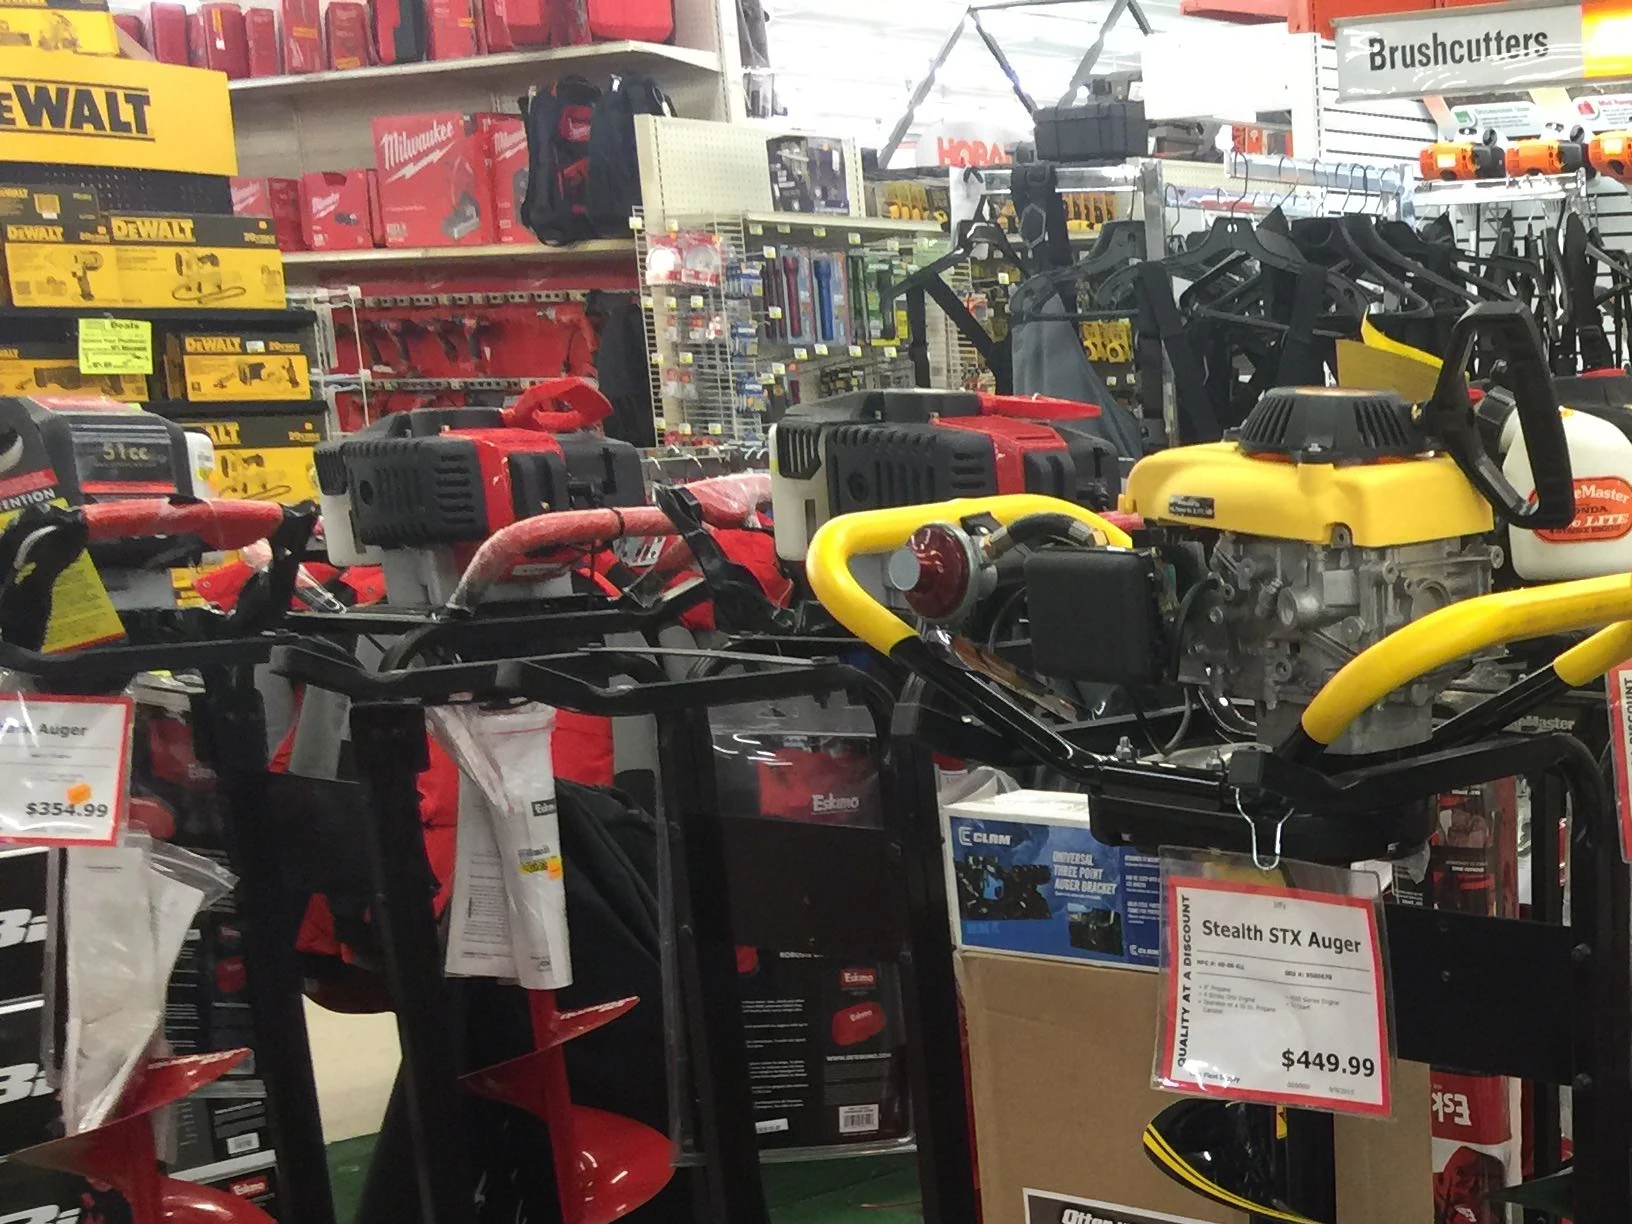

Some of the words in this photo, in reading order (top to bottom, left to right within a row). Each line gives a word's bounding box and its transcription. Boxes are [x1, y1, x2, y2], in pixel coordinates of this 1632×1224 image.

[1368, 28, 1549, 71] Brushcutters
[0, 83, 151, 135] EWALT
[382, 120, 455, 170] Milwaukee
[7, 224, 64, 242] DEWALT
[112, 216, 196, 242] DEWALT
[185, 336, 241, 353] DEWALT
[103, 442, 149, 461] 51cc
[0, 487, 56, 511] ENTION
[1584, 513, 1630, 528] LITE
[40, 723, 88, 738] Auger
[25, 802, 108, 818] $354.99
[812, 793, 859, 813] Eskimo
[973, 831, 1012, 845] CLAM
[1053, 851, 1094, 866] UNIVERSAL
[1054, 866, 1077, 879] THREE
[1079, 868, 1104, 880] POINT
[1054, 878, 1080, 892] AUGER
[1081, 881, 1118, 895] BRACKET
[1181, 895, 1192, 967] DISCOUNT
[1202, 919, 1263, 942] Stealth
[1269, 927, 1301, 946] STX
[1308, 931, 1361, 954] Auger
[844, 972, 874, 984] Eskimo
[1183, 971, 1191, 981] A
[1181, 985, 1191, 1003] AT
[1177, 1007, 1192, 1067] QUALITY
[1281, 1049, 1375, 1077] $449.99
[1432, 1091, 1473, 1127] Esk
